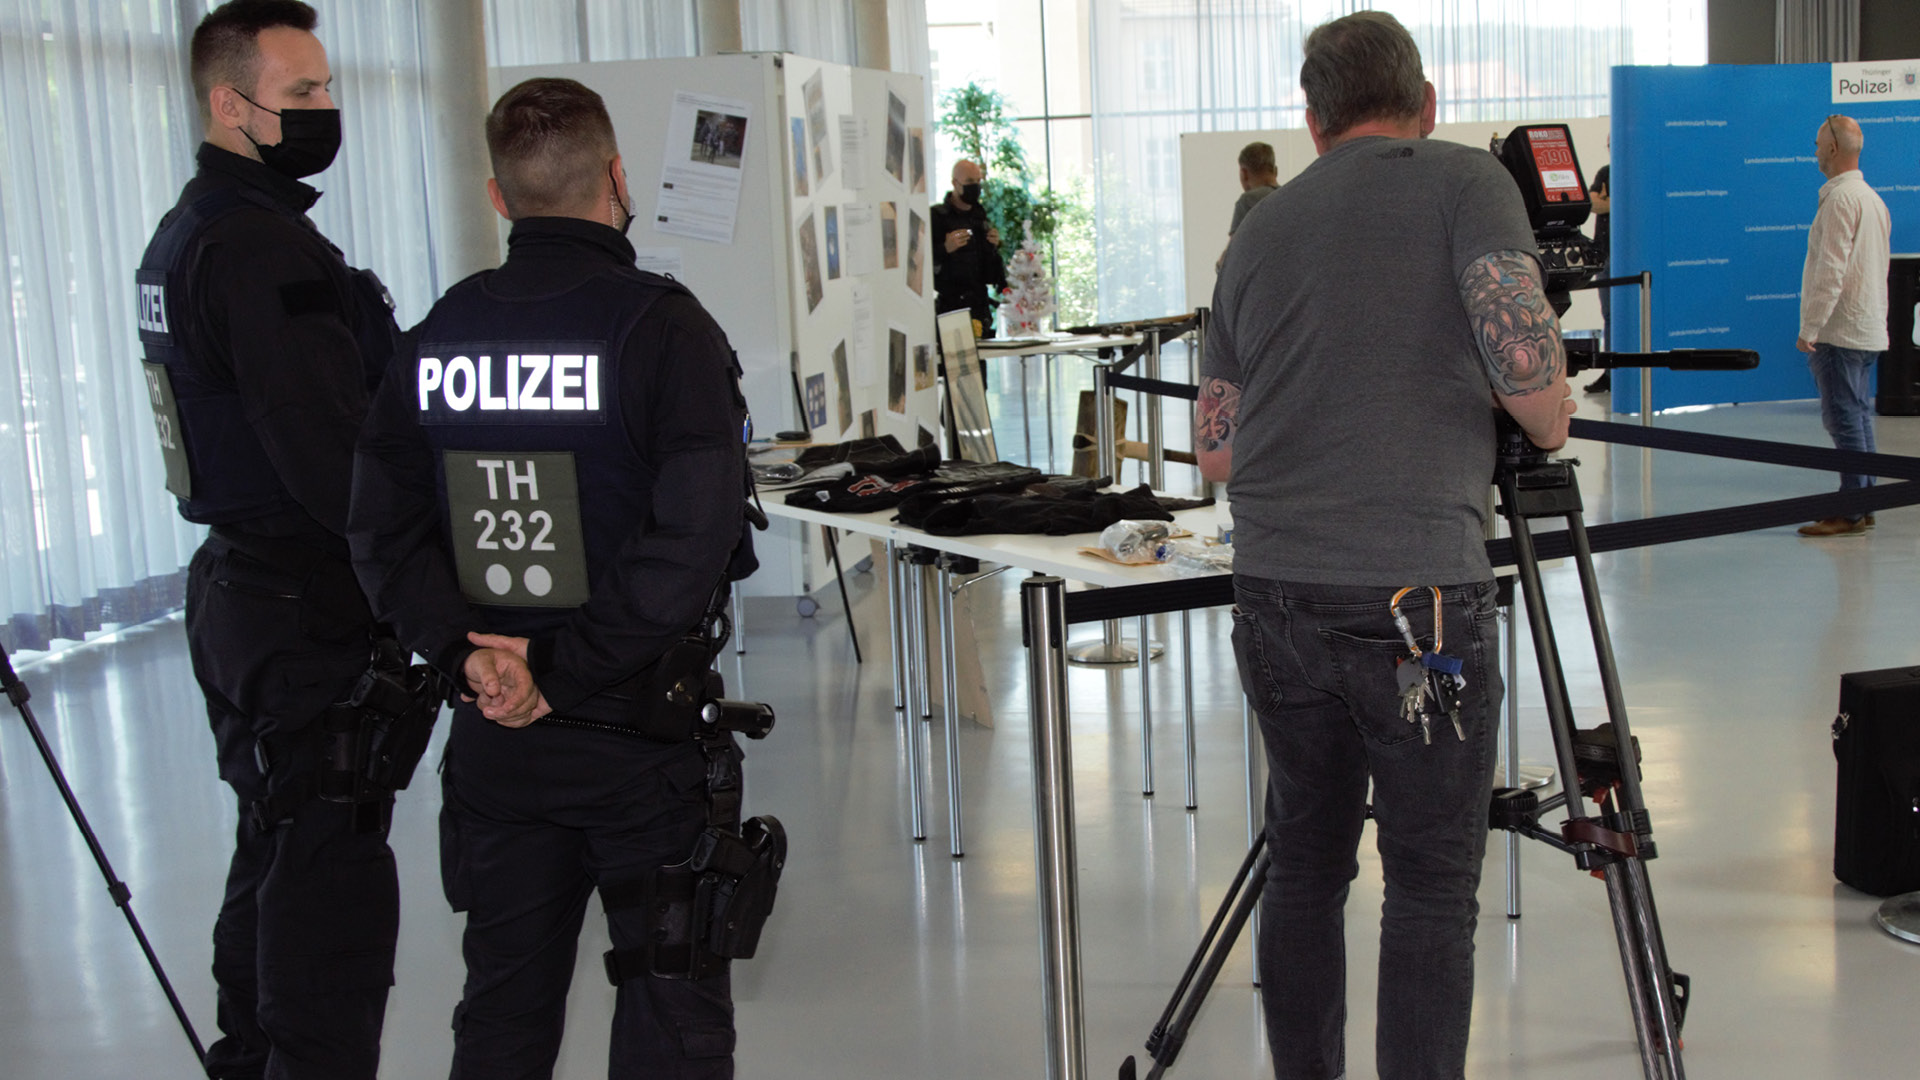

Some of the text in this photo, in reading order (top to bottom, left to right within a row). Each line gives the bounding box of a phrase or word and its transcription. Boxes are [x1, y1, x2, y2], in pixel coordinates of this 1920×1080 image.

[1839, 79, 1893, 95] Polizei
[418, 355, 599, 411] POLIZEI
[153, 410, 176, 450] 32
[476, 459, 539, 500] TH
[473, 509, 556, 551] 232
